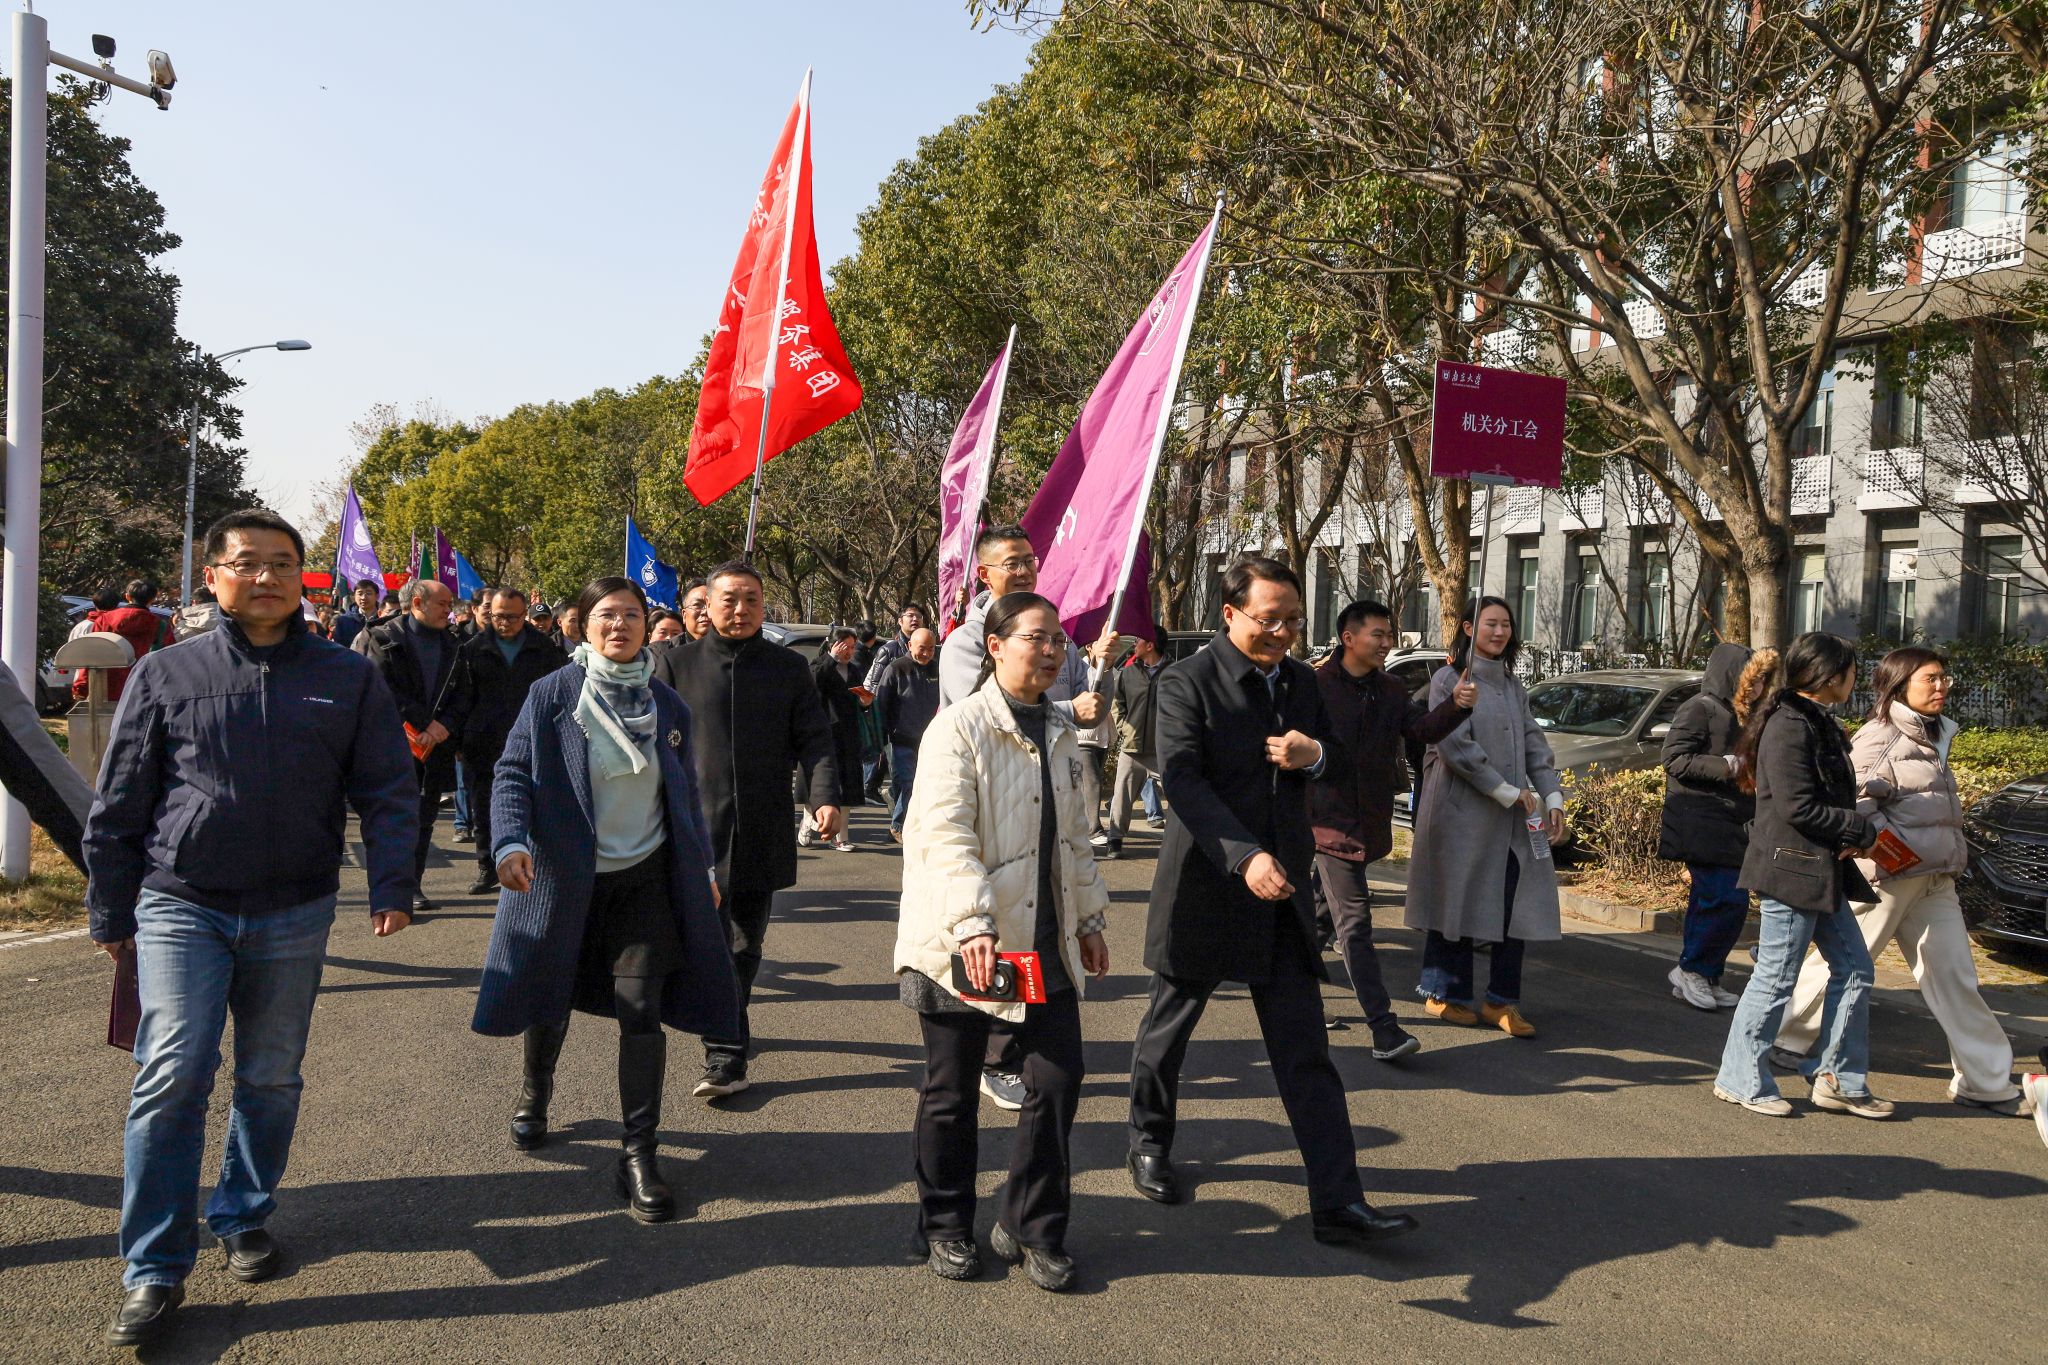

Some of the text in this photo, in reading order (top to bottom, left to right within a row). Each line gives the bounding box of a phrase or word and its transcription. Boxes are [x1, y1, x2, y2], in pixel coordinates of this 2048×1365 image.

[1462, 412, 1538, 440] 机关分工会
